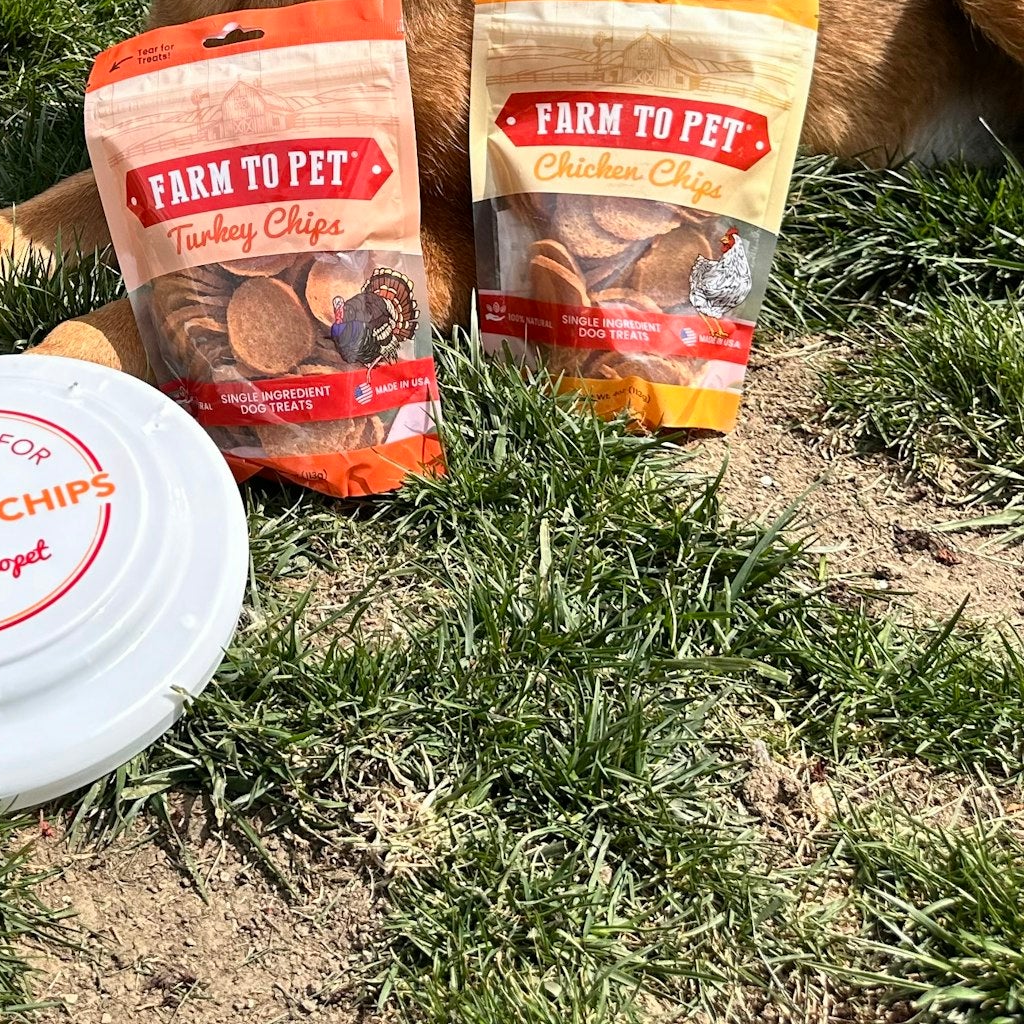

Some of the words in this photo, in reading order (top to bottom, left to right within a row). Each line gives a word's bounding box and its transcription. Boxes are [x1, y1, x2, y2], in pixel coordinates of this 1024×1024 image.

[137, 46, 158, 56] Tear
[160, 43, 174, 52] for
[137, 52, 171, 65] Treats!
[535, 101, 622, 136] FARM
[633, 104, 674, 140] TO
[679, 110, 745, 154] PET
[147, 159, 234, 211] FARM
[241, 153, 279, 191] TO
[288, 150, 348, 188] PET
[534, 151, 644, 182] Chicken
[648, 159, 722, 204] Chips
[167, 214, 258, 255] Turkey
[263, 204, 344, 247] Chips
[525, 316, 553, 329] NATURAL
[562, 315, 599, 328] SINGLE
[602, 318, 661, 333] INGREDIENT
[578, 327, 606, 339] DOG
[609, 329, 650, 341] TREATS
[698, 334, 716, 344] MADE
[716, 337, 723, 345] IN
[723, 338, 741, 349] USA
[221, 393, 258, 404] SINGLE
[262, 386, 331, 401] INGREDIENT
[375, 382, 398, 395] MADE
[400, 380, 410, 389] IN
[411, 377, 431, 387] USA
[240, 404, 267, 415] DOG
[269, 399, 314, 413] TREATS
